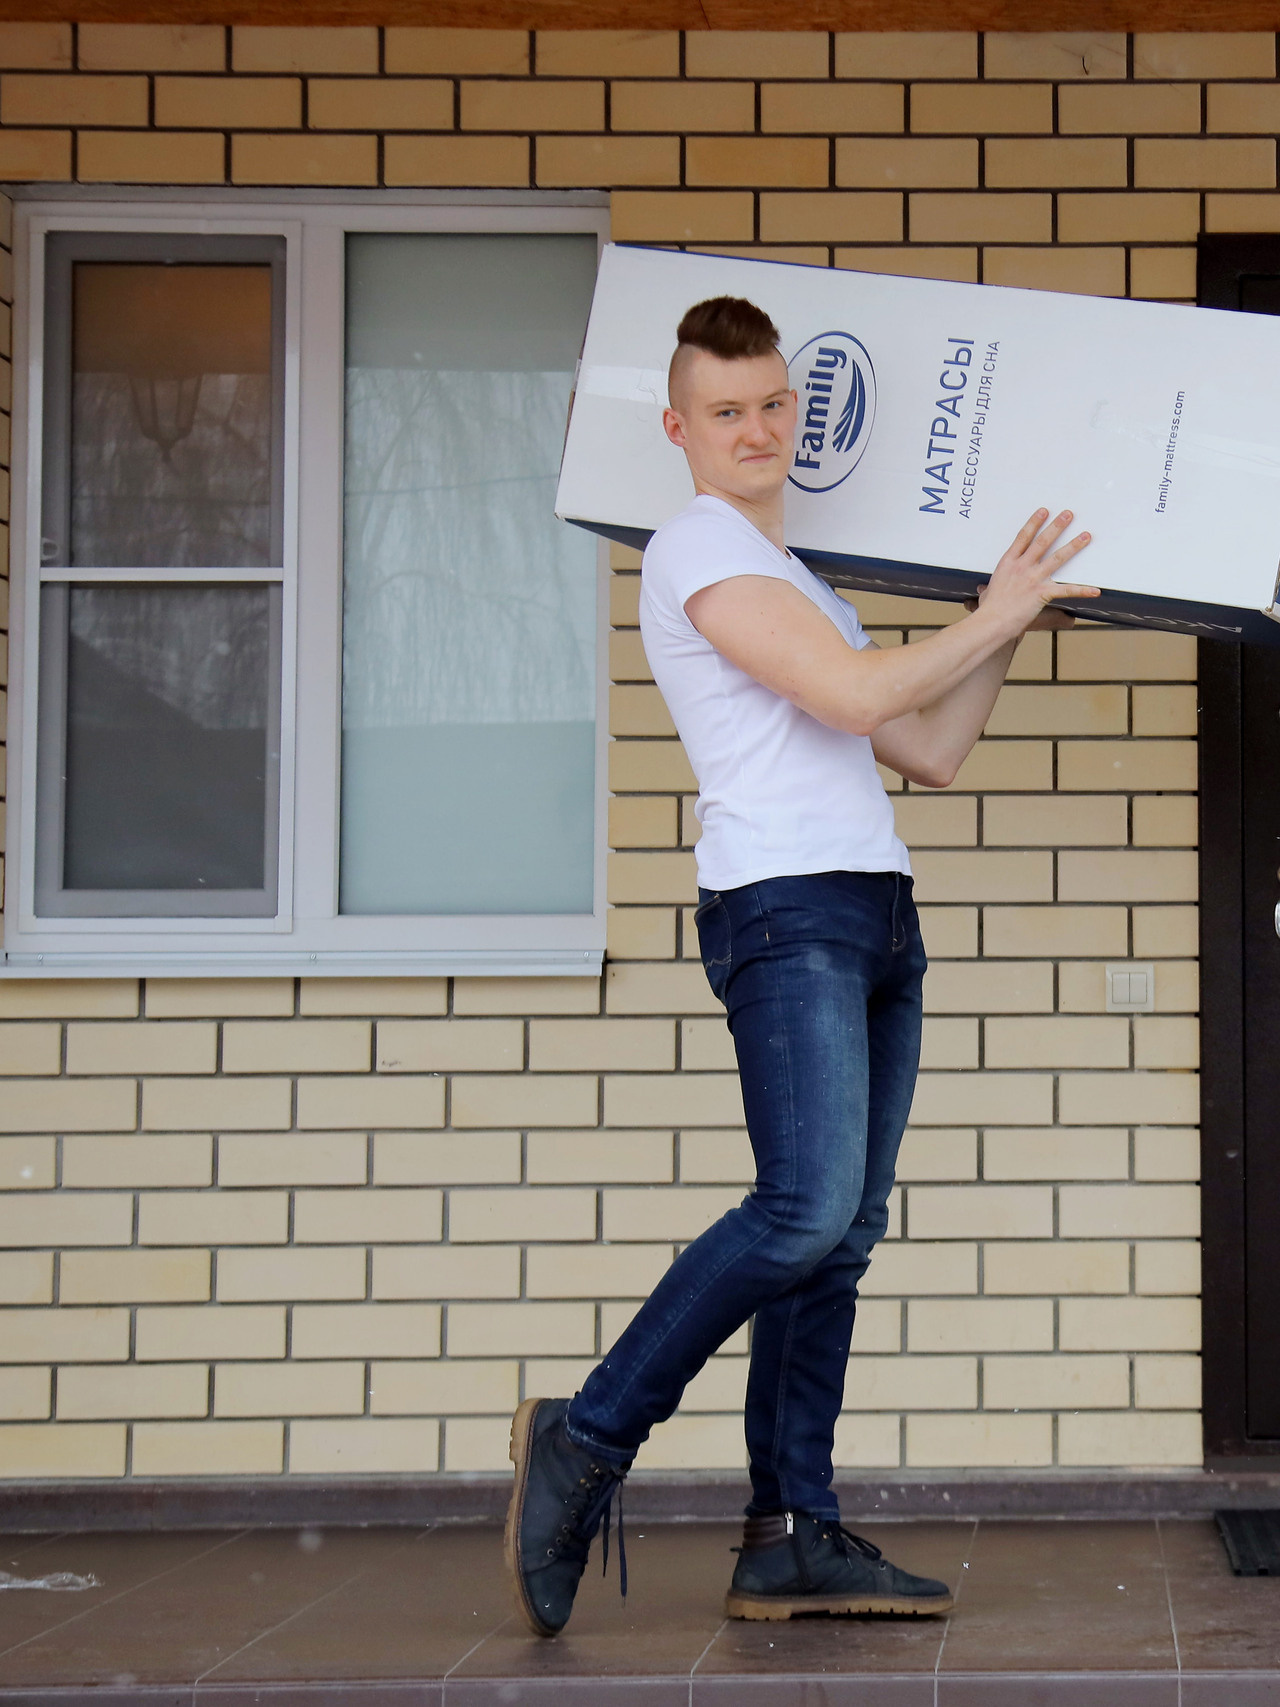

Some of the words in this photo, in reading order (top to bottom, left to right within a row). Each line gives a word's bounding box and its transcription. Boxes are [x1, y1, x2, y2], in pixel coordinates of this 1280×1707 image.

[794, 346, 848, 470] Family
[975, 375, 994, 410] ДЛЯ
[983, 340, 1001, 372] СНА
[918, 337, 975, 515] МАТРАСЫ
[958, 411, 987, 520] АКСЕССУАРЫ
[1154, 390, 1186, 513] family-mattress.com
